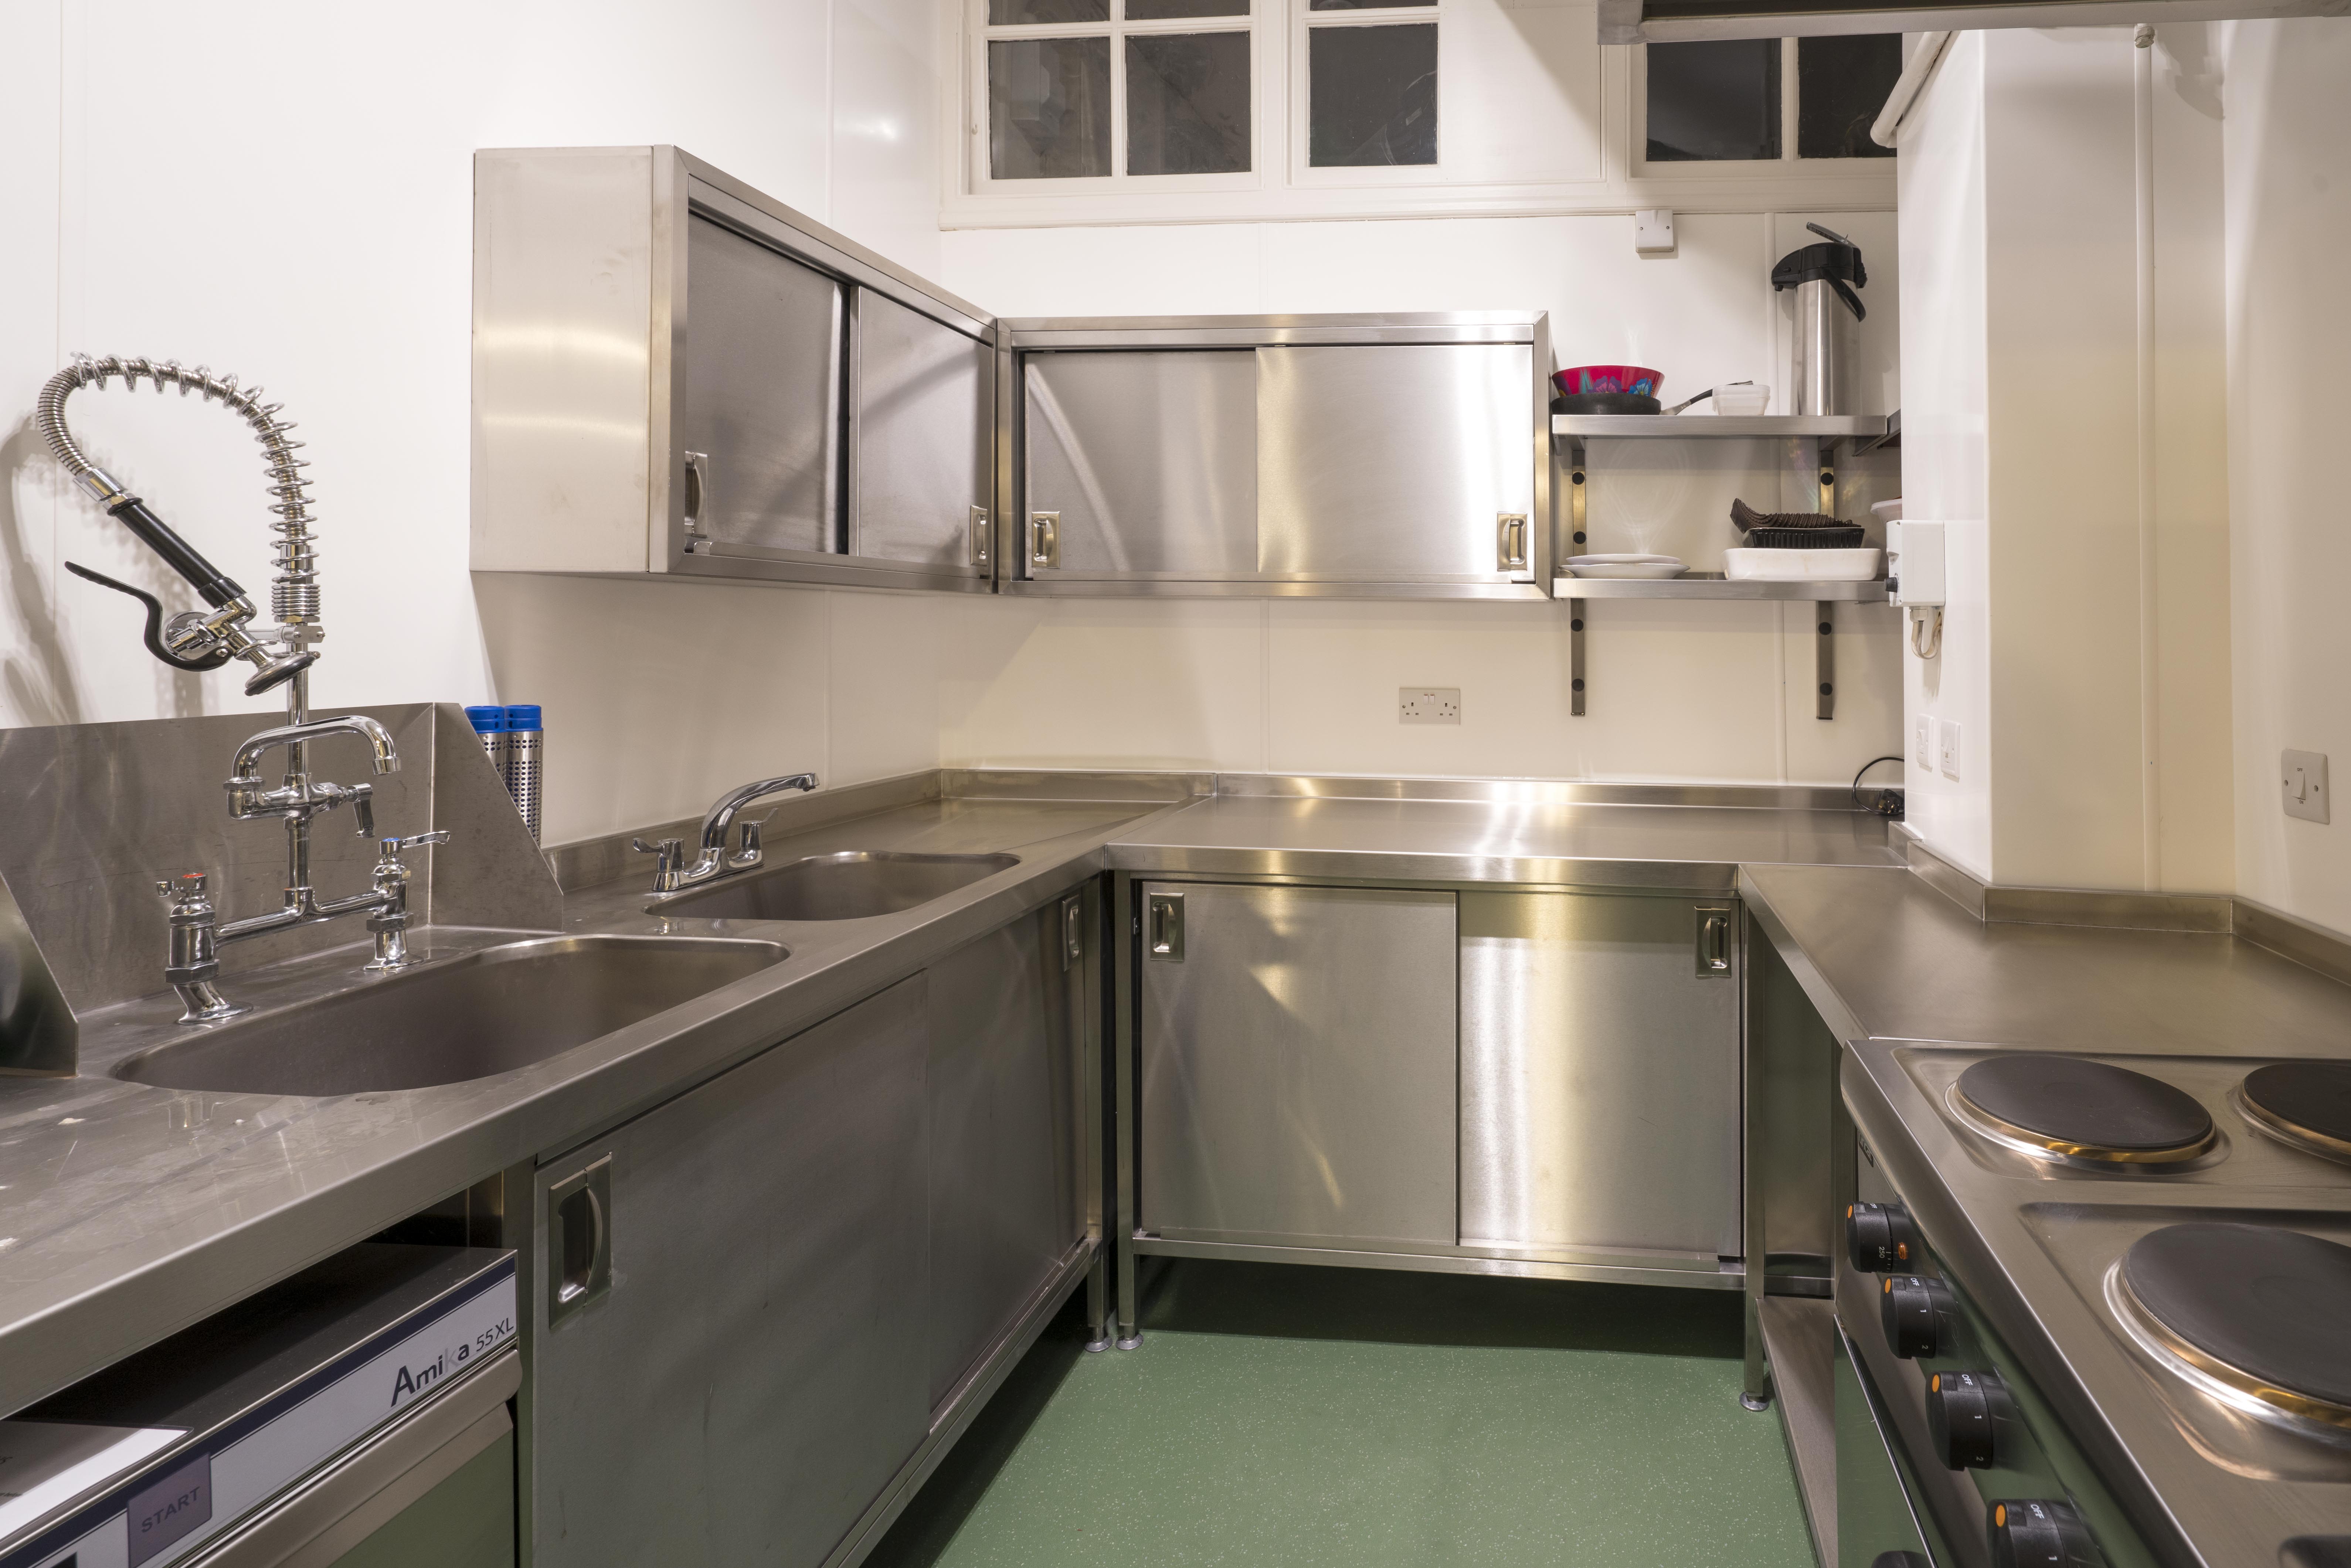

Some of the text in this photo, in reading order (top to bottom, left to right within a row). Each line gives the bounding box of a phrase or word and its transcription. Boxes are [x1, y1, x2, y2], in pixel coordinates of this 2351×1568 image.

[1910, 1278, 1919, 1286] OFF
[391, 1344, 469, 1407] Amika
[1962, 1374, 1973, 1386] OFF
[141, 1486, 200, 1533] START
[2030, 1504, 2044, 1519] OFF
